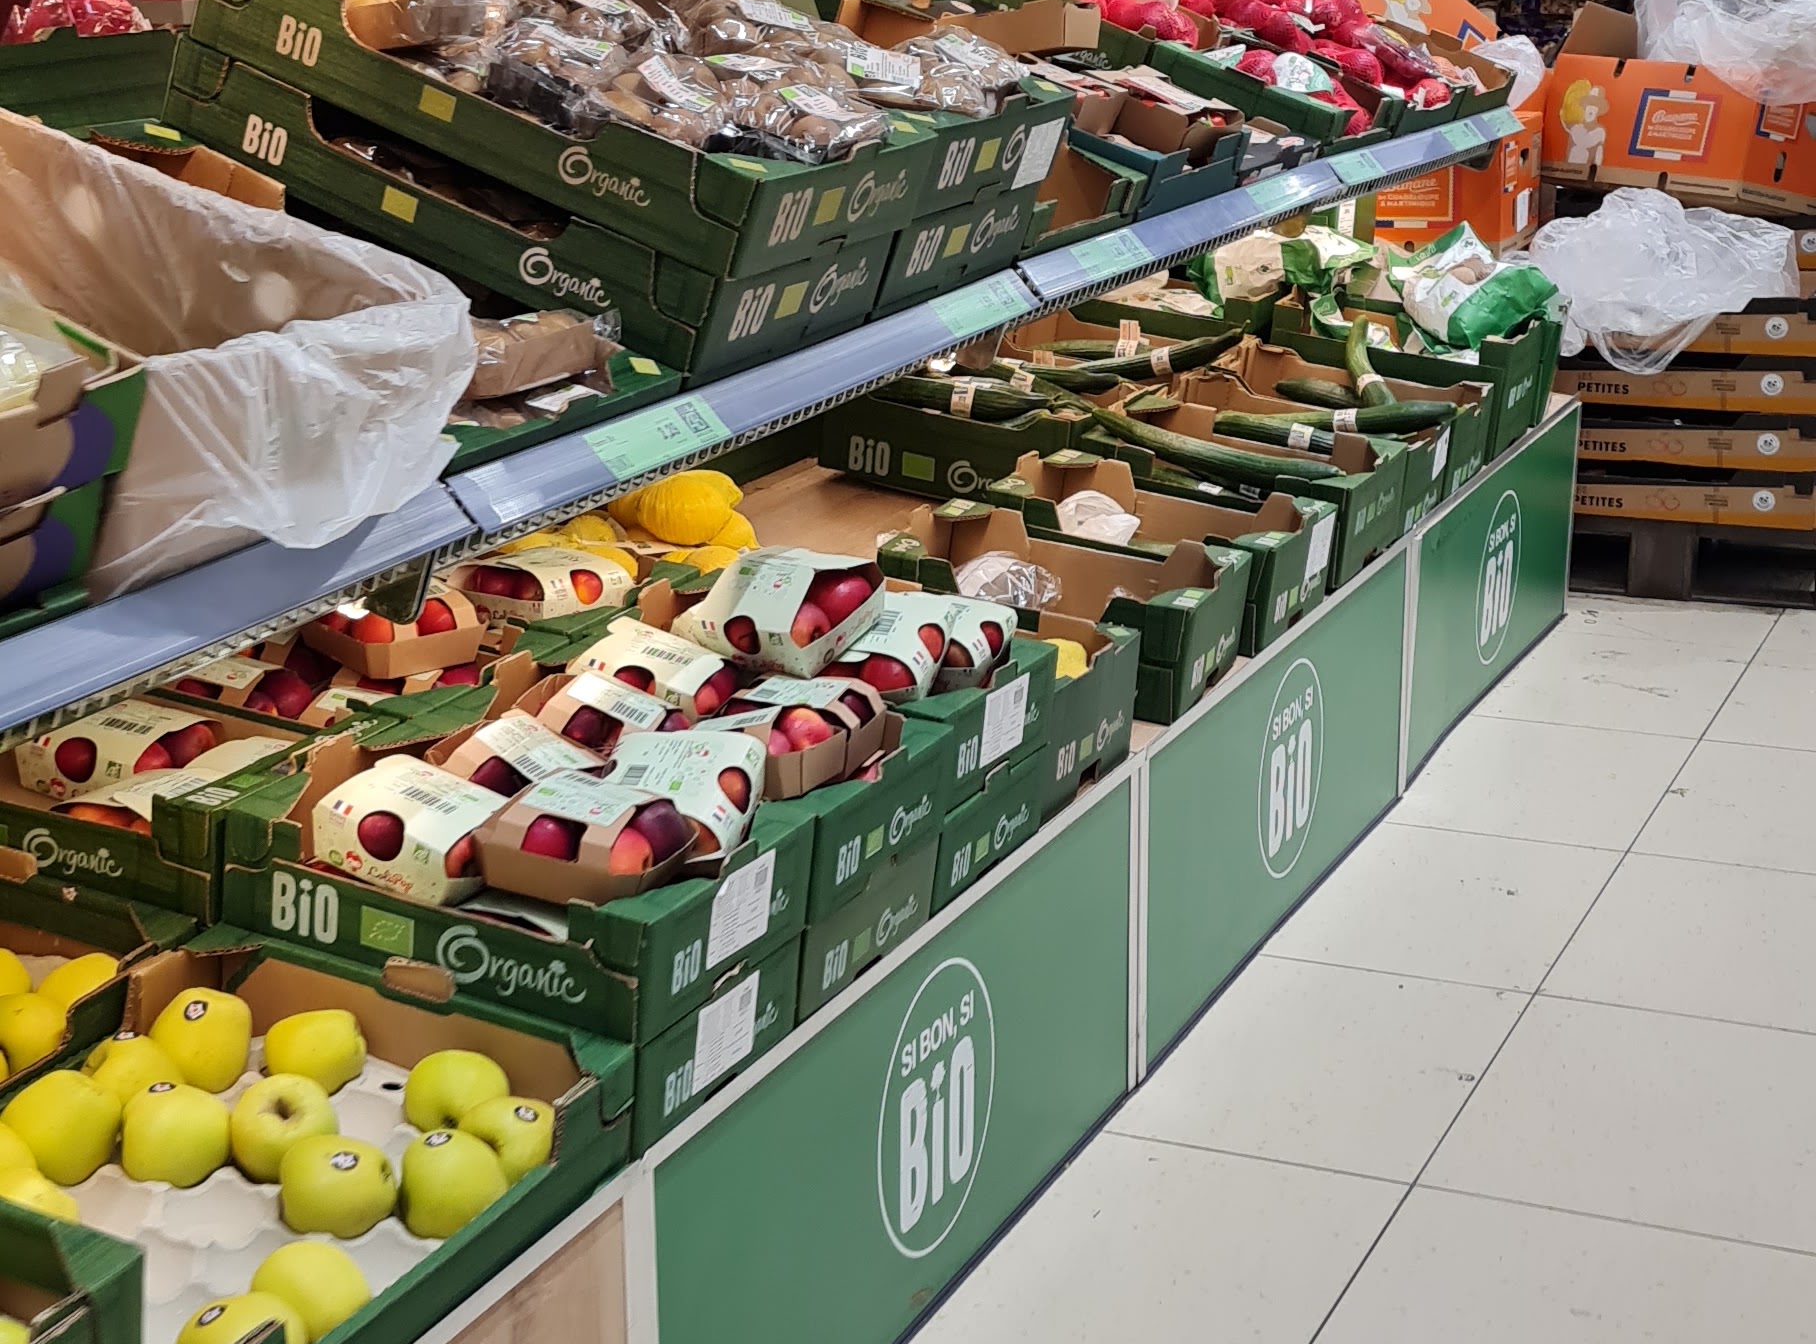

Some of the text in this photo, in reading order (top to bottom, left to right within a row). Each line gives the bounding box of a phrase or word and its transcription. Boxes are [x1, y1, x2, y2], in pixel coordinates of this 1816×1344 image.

[558, 145, 650, 206] Organic
[847, 169, 909, 223] Organic
[518, 247, 611, 307] Organic
[809, 257, 869, 314] Organic
[1578, 382, 1629, 395] PETITES
[1272, 714, 1282, 741] SI
[1304, 685, 1314, 710] SI
[22, 828, 123, 879] Organic
[436, 925, 587, 1004] Organic
[901, 989, 975, 1078] SI BON, SI
